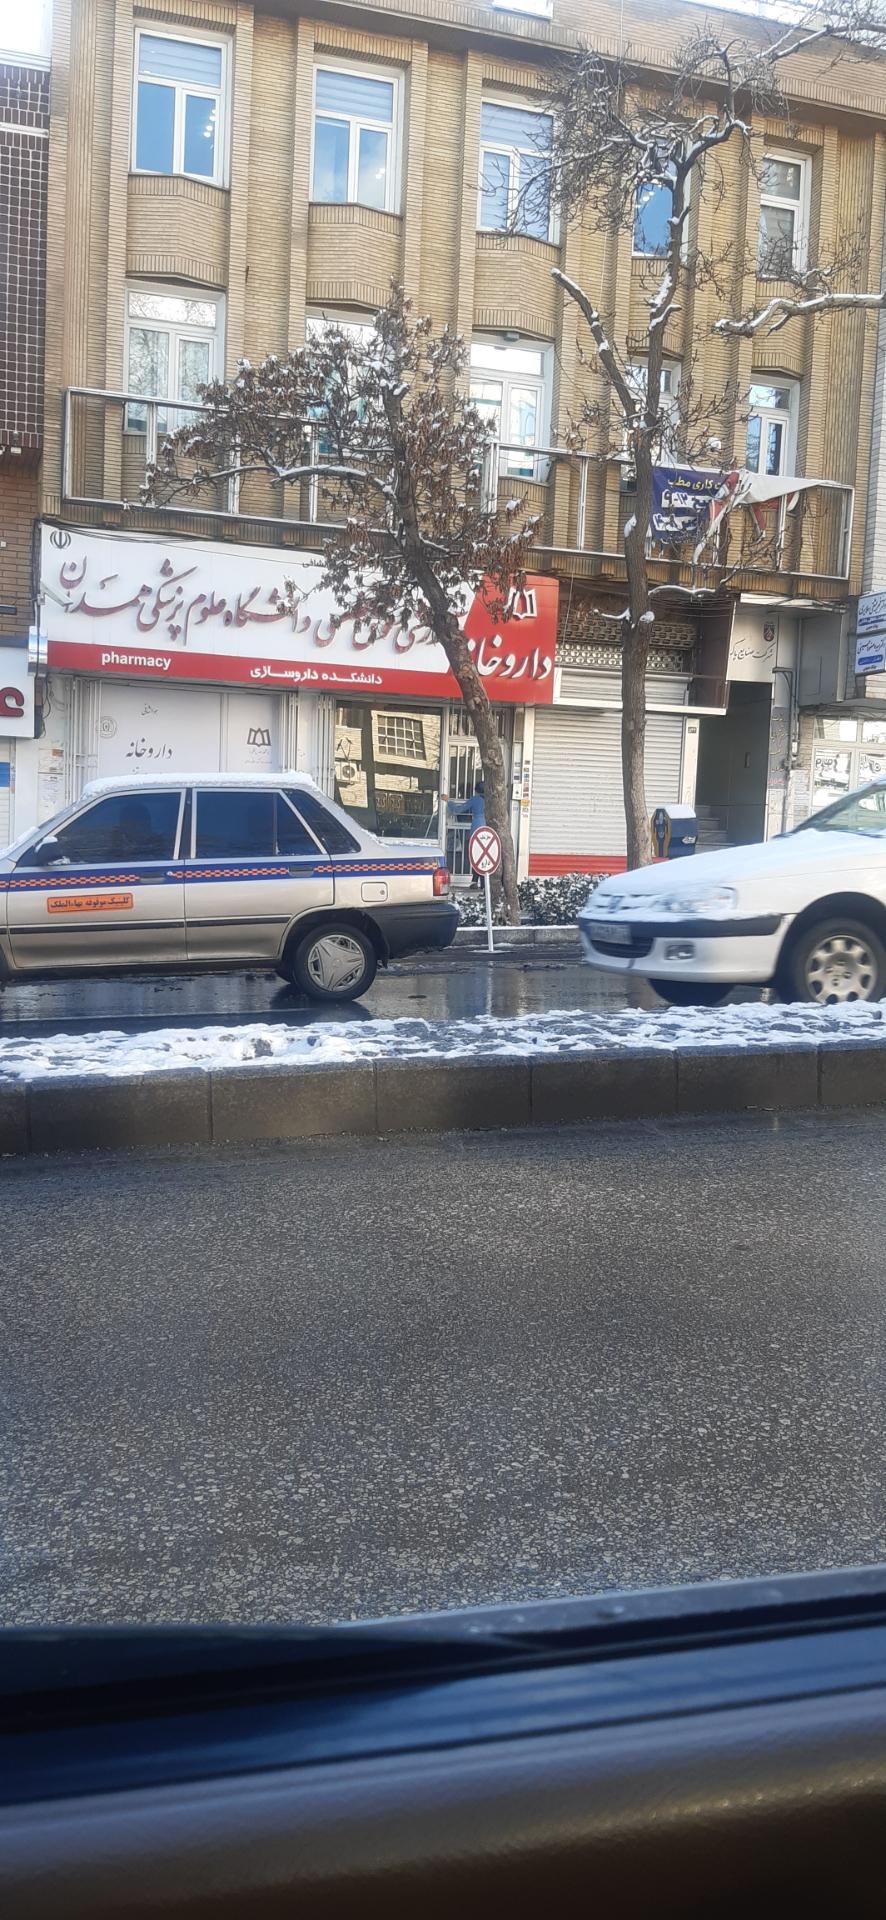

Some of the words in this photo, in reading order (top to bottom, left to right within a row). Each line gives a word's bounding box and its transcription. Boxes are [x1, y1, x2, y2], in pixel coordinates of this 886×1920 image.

[667, 476, 691, 488] مطب
[184, 590, 227, 646] علوم
[101, 650, 172, 671] pharmacy
[466, 633, 552, 680] داروخا
[250, 665, 319, 682] داروسازی
[321, 671, 383, 685] دانشکده
[125, 737, 173, 760] داروخانه
